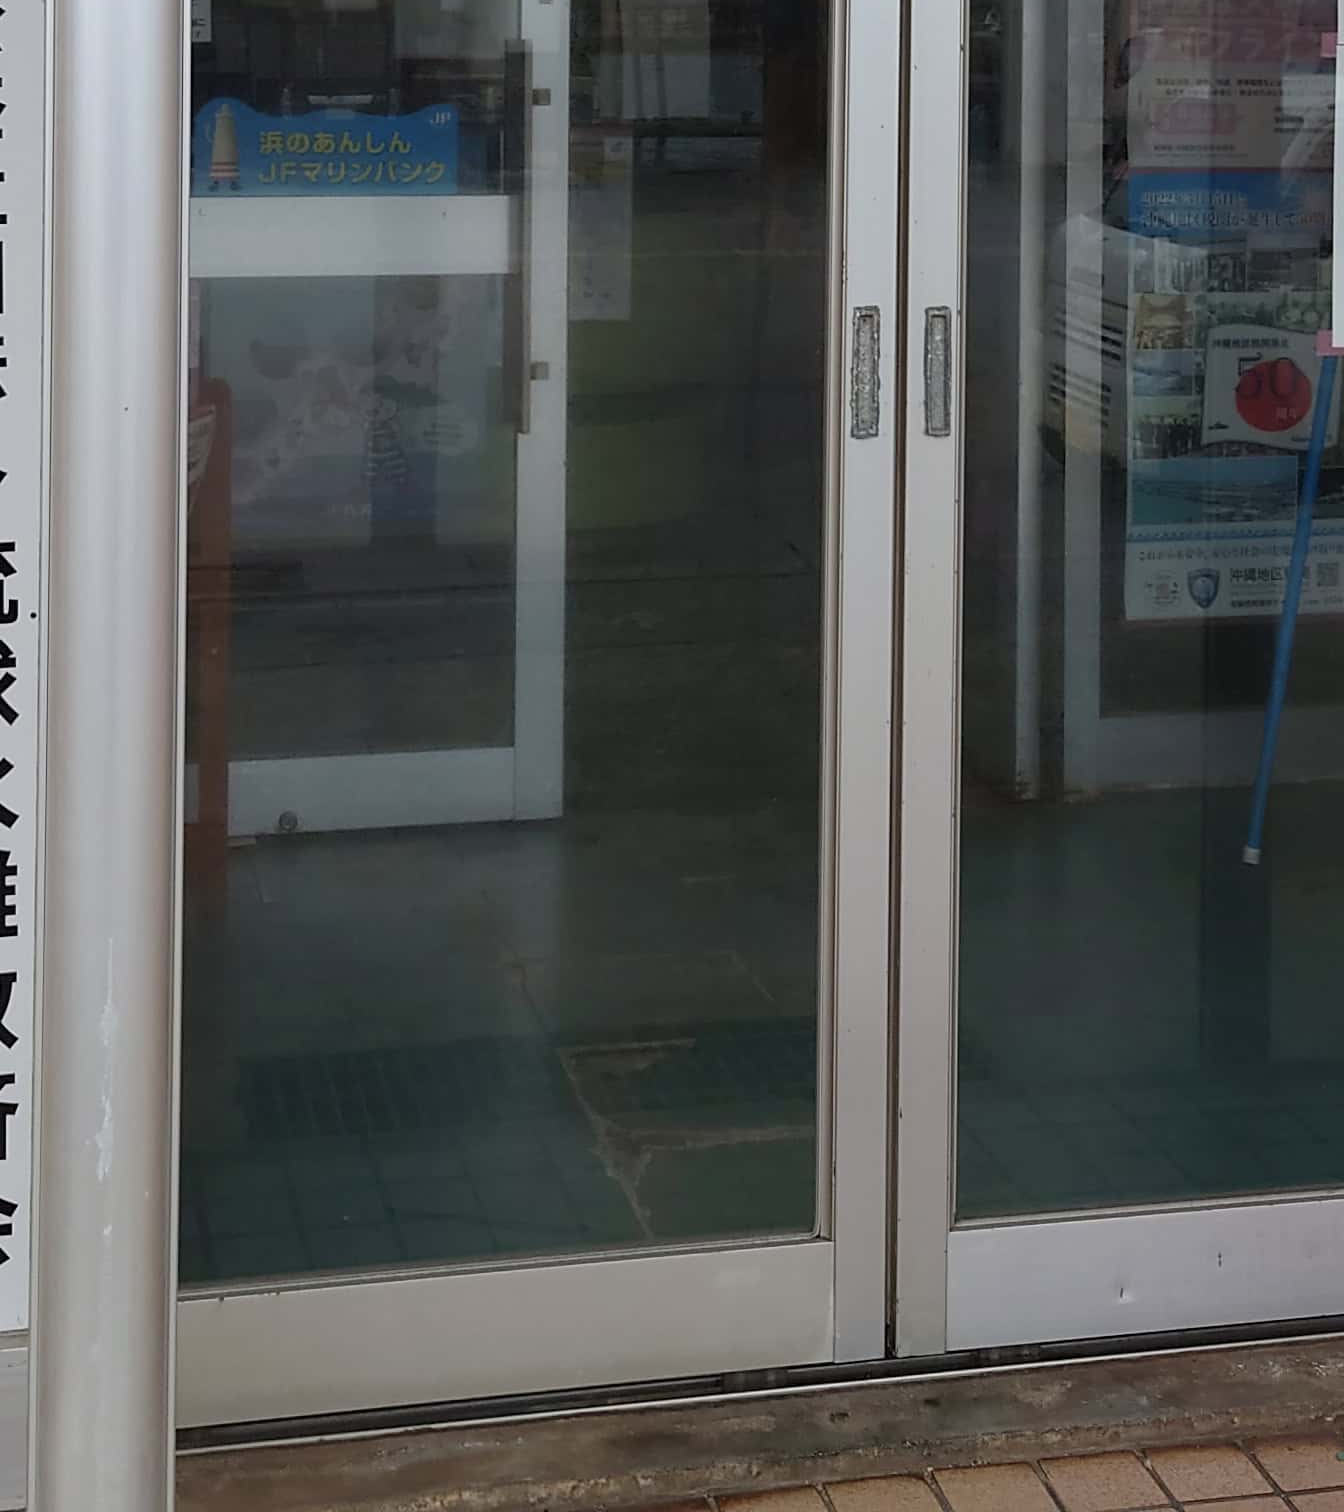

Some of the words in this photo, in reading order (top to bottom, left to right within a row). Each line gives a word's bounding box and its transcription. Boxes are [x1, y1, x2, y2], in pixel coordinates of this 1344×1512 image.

[258, 131, 413, 156] 浜のあんしん
[258, 160, 447, 185] JFマリンバンク
